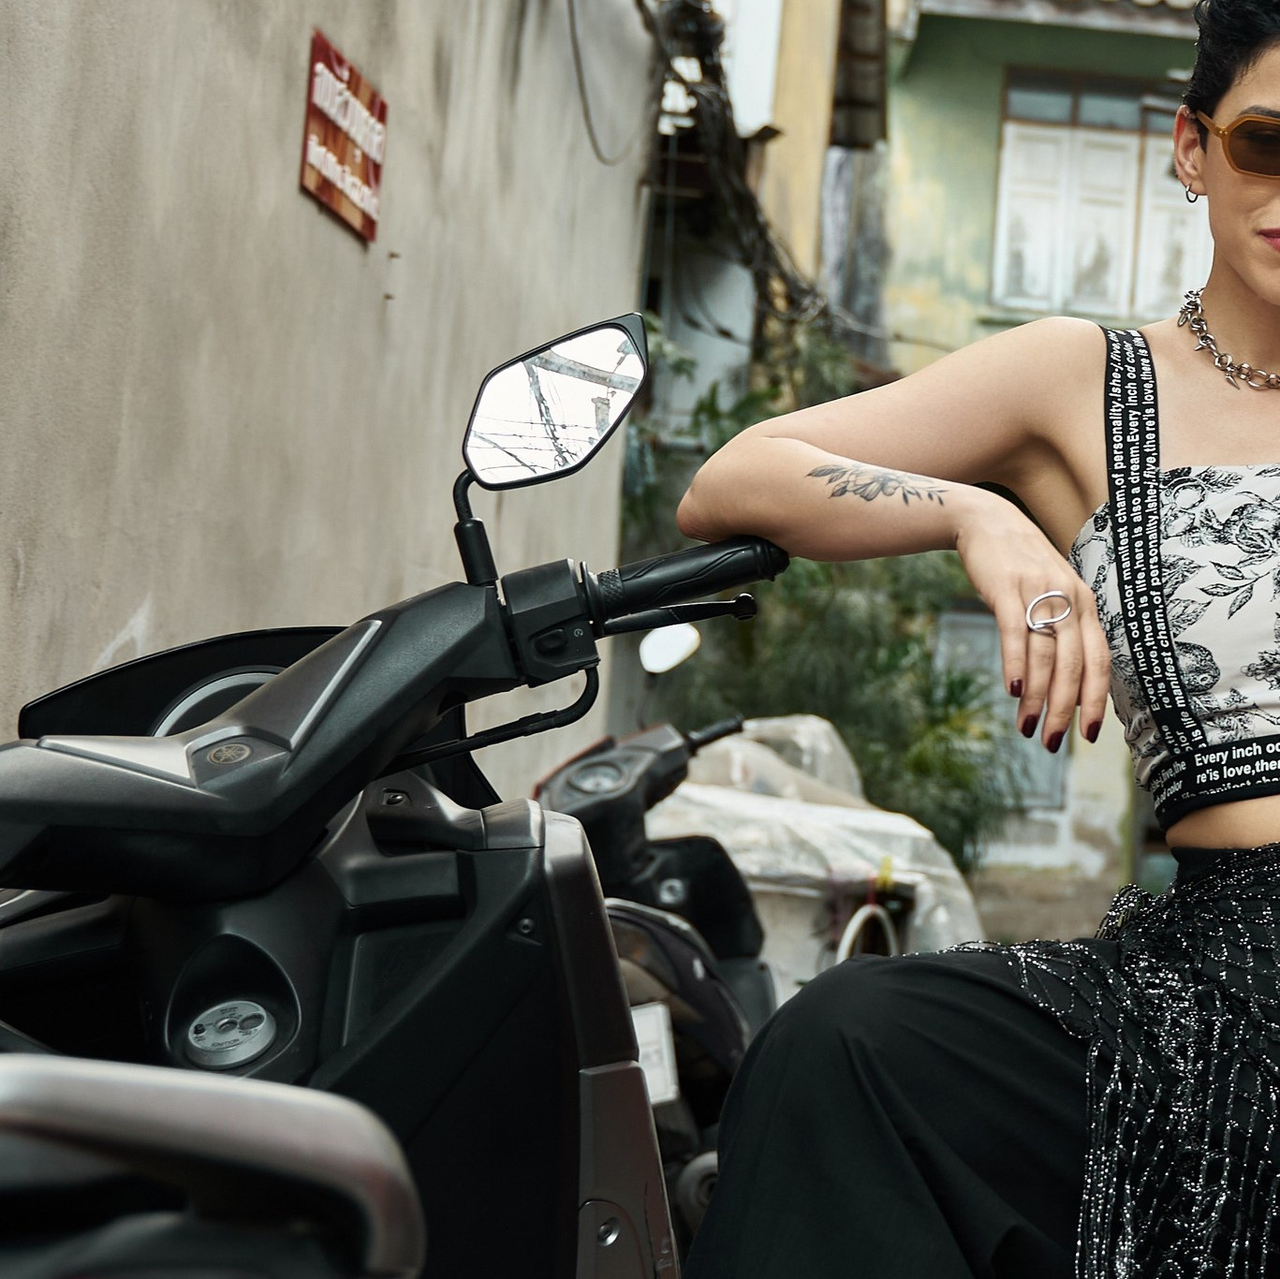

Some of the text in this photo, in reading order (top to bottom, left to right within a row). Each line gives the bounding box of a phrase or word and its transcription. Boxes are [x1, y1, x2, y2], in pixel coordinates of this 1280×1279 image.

[1123, 340, 1136, 364] color
[1136, 348, 1149, 357] is
[1124, 364, 1137, 379] od
[1124, 382, 1138, 406] inch
[1131, 486, 1141, 494] a
[1130, 497, 1142, 523] also
[1131, 526, 1143, 538] is
[1116, 525, 1132, 581] manifest
[1124, 584, 1136, 618] color
[1138, 595, 1149, 608] is
[1127, 621, 1140, 638] od
[1133, 642, 1148, 672] inch
[1160, 651, 1186, 708] manifest
[1142, 675, 1161, 712] Every
[1180, 711, 1197, 729] life
[1191, 729, 1203, 742] is
[1194, 750, 1229, 767] Every
[1232, 742, 1262, 760] inch
